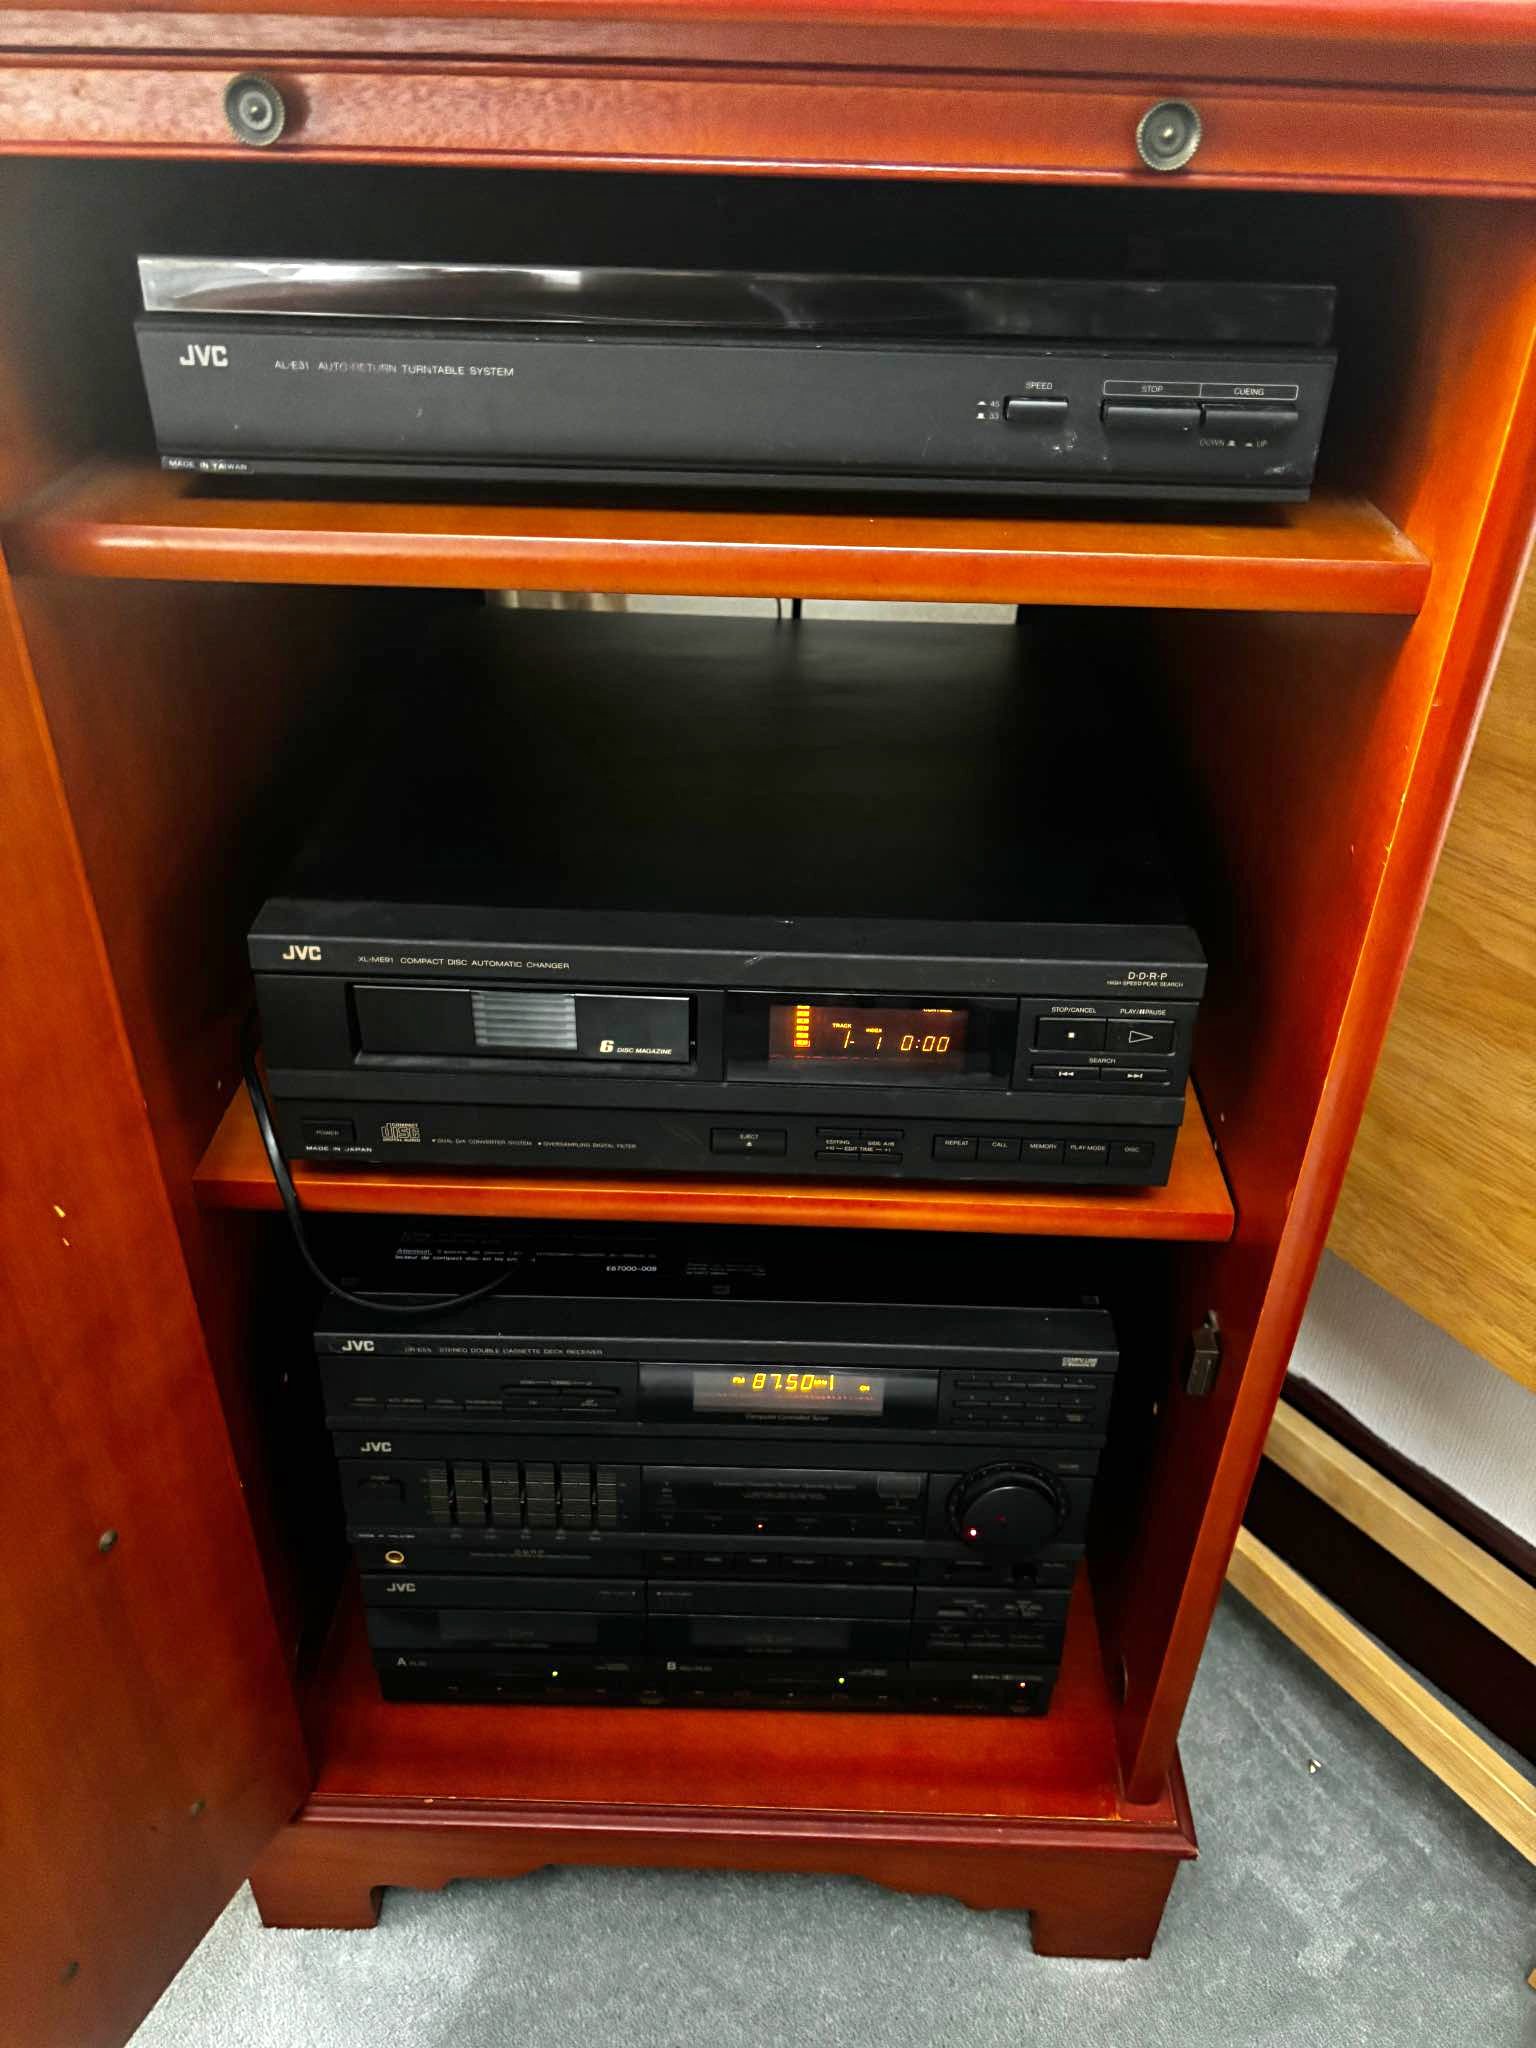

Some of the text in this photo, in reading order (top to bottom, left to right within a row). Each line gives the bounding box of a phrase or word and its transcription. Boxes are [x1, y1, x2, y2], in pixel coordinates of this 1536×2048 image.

[178, 344, 229, 367] JVC
[401, 364, 465, 375] TURNTABLE
[469, 366, 514, 376] SYSTEM
[1024, 381, 1053, 391] SPEED
[1141, 384, 1164, 393] STOP
[1199, 438, 1225, 448] DOWN
[1256, 440, 1268, 448] UP
[168, 460, 247, 471] MADE IN TAIWAN
[283, 945, 322, 961] JVC
[400, 956, 445, 966] COMPACT
[447, 958, 469, 967] DISC
[471, 960, 523, 969] AUTOMATIC
[526, 961, 571, 970] CHANGER
[1051, 1006, 1096, 1014] STOP/CANCEL
[599, 1039, 615, 1053] 6
[635, 1048, 672, 1056] MAGAZINE
[900, 1035, 950, 1053] 0:00
[1089, 1056, 1116, 1065] SEARCH
[305, 1144, 330, 1152] MADE
[345, 1145, 373, 1153] JAPAN
[944, 1139, 969, 1147] REPEAT
[991, 1141, 1008, 1149] CALL
[1029, 1143, 1057, 1151] MEMORY
[341, 1339, 376, 1352] JVC
[360, 1440, 393, 1453] JVC
[386, 1582, 418, 1593] JVC
[396, 1656, 408, 1668] A
